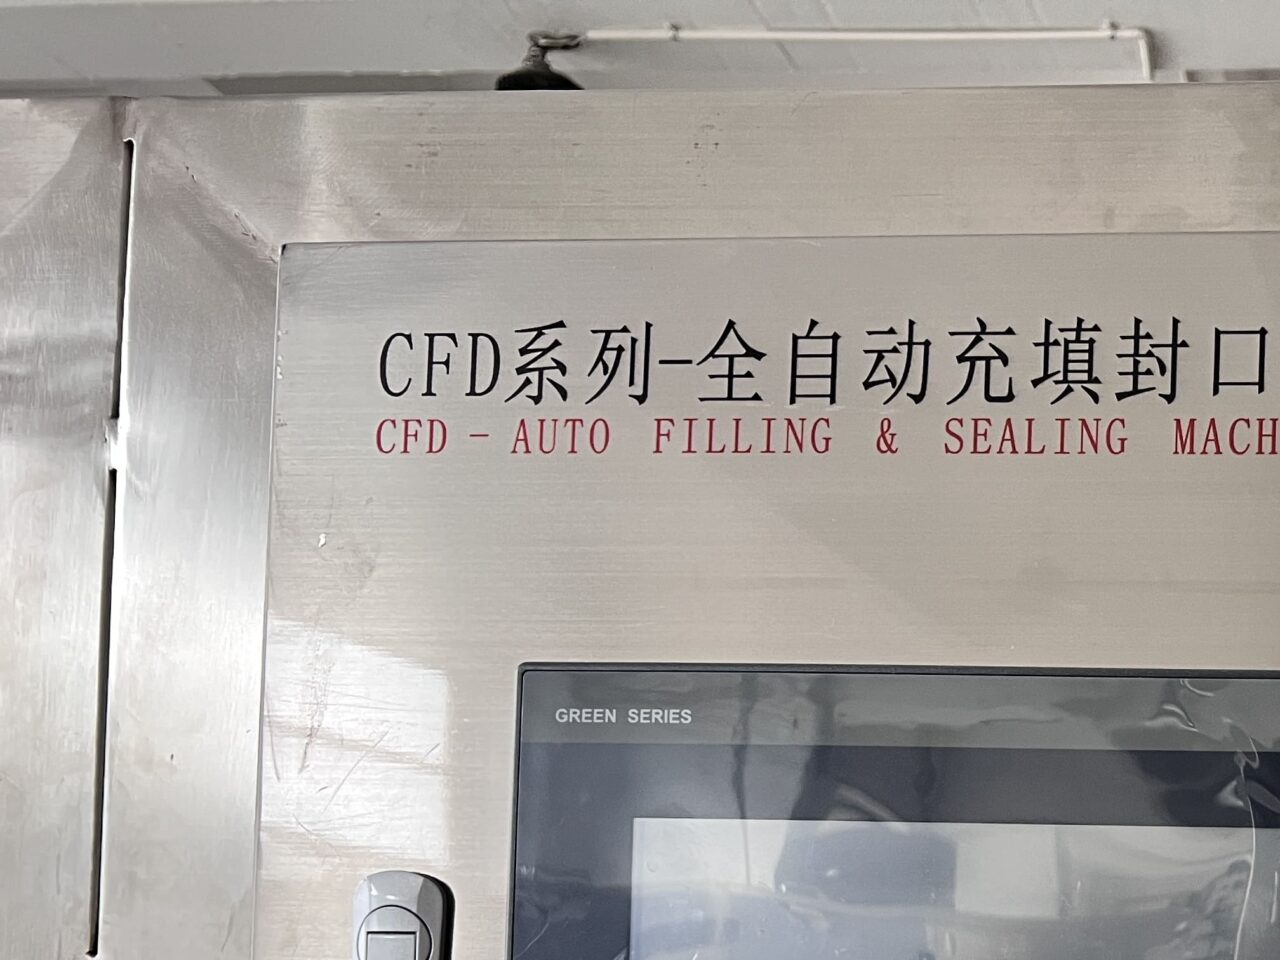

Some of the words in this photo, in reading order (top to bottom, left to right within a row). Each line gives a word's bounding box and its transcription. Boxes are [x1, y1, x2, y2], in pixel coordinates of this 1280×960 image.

[374, 418, 449, 456] CFD
[511, 418, 612, 456] AUTO
[652, 418, 834, 456] FILLING
[874, 418, 900, 456] &
[943, 418, 1129, 456] SEALING
[555, 708, 617, 723] GREEN
[627, 709, 692, 724] SERIES
